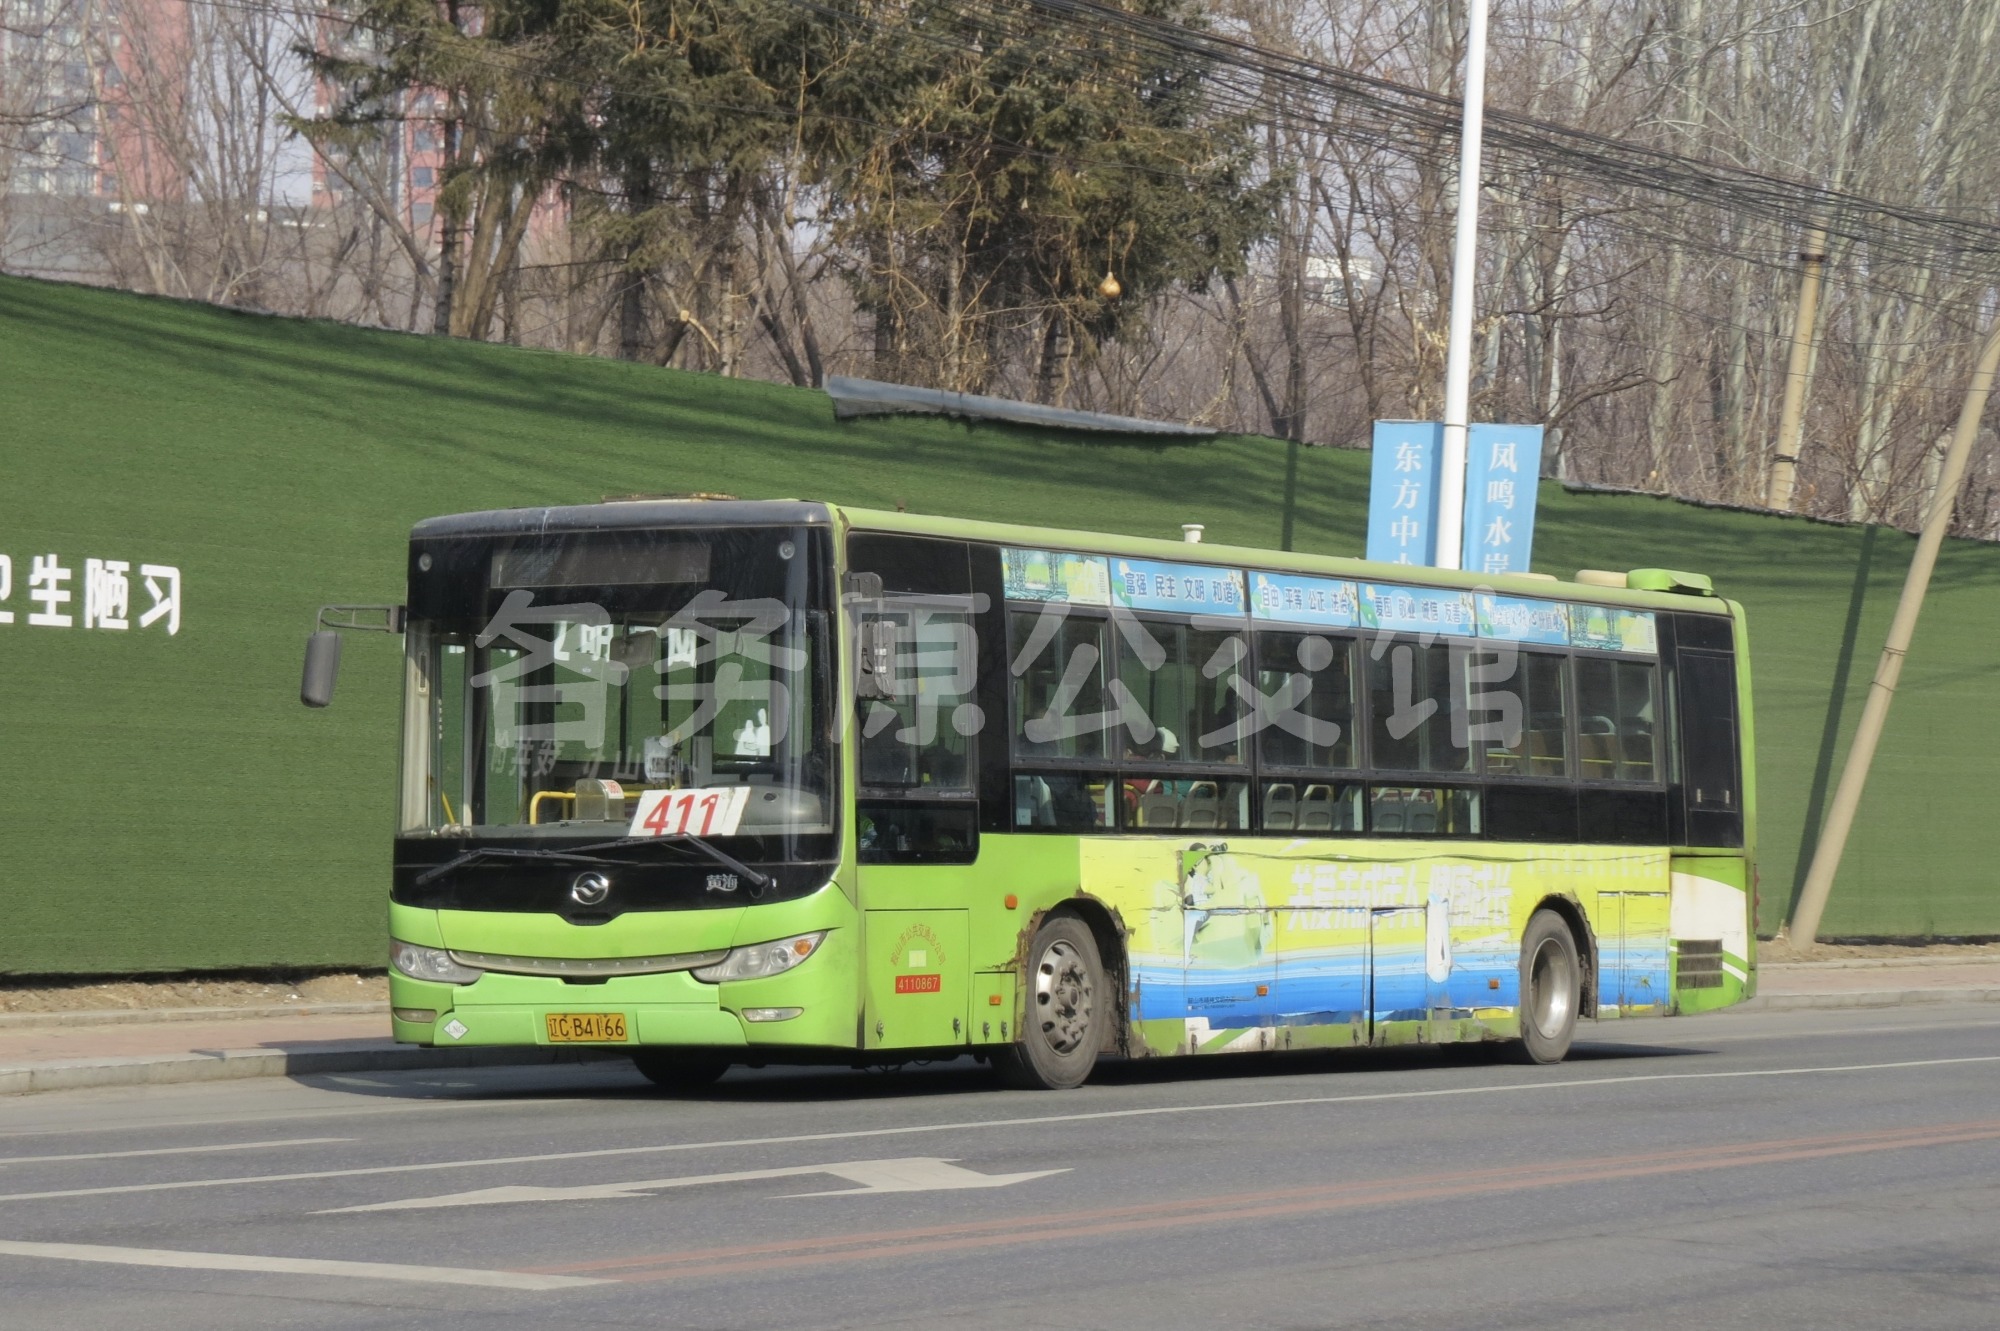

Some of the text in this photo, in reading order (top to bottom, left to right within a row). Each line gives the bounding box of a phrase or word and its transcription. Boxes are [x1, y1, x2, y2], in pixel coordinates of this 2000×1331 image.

[0, 553, 181, 637] 生陋习
[1125, 572, 1147, 596] 富强
[1155, 576, 1177, 599] 民主
[1184, 578, 1205, 601] 文明
[1212, 580, 1233, 604] 和谐
[1262, 586, 1349, 615] 自由 平等 公正 法治
[1374, 596, 1393, 619] 爱国
[1421, 600, 1439, 623] 诚信
[1444, 602, 1461, 624] 友善
[643, 793, 720, 837] 411
[706, 873, 738, 892] 黄海
[898, 976, 938, 991] 4110867
